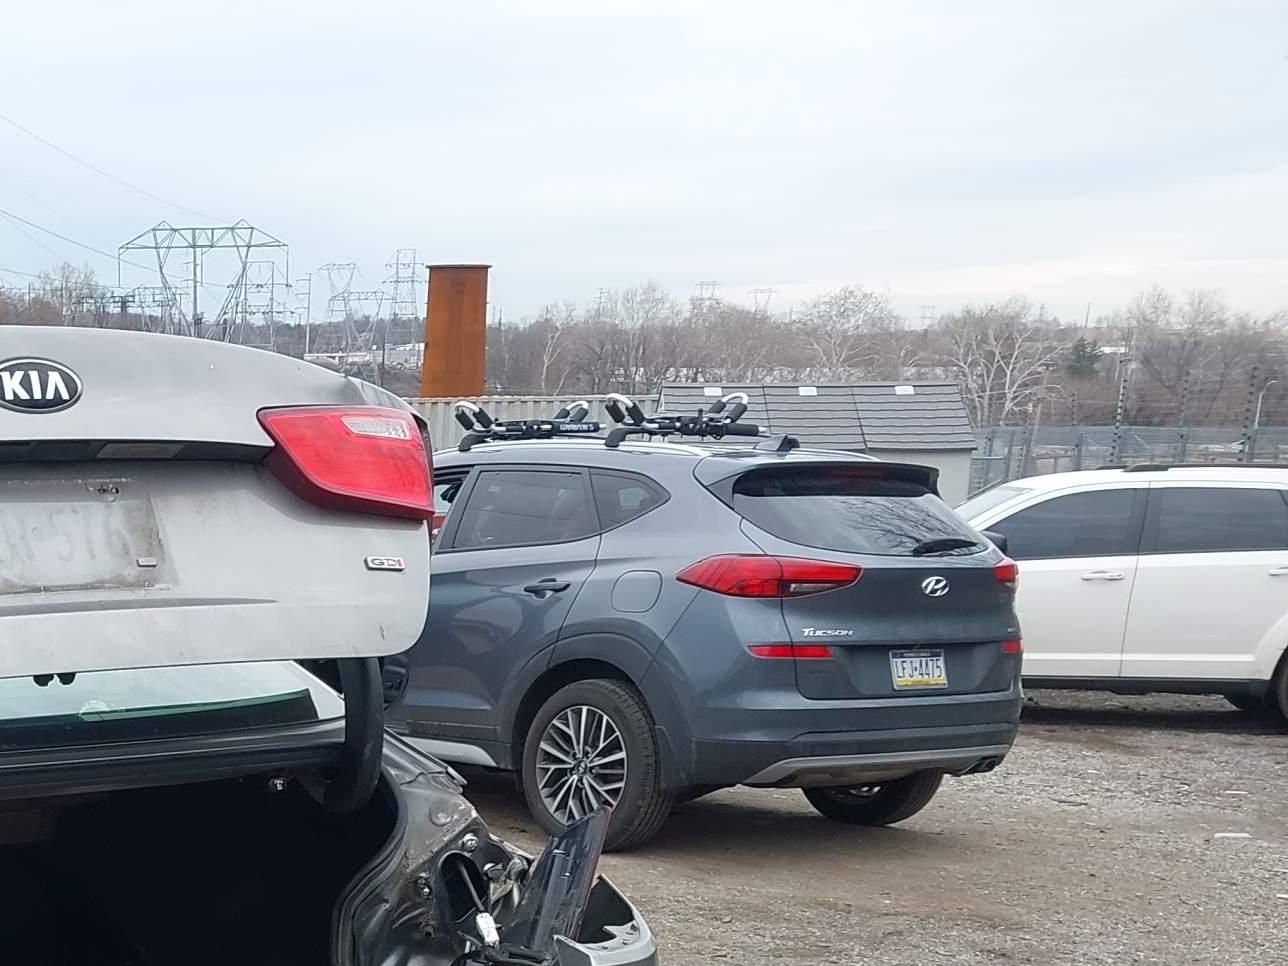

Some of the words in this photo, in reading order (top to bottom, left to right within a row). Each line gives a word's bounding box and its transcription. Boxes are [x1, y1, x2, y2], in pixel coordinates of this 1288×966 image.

[0, 370, 71, 400] KIA
[371, 558, 403, 567] GDI
[801, 627, 854, 637] TUCSON
